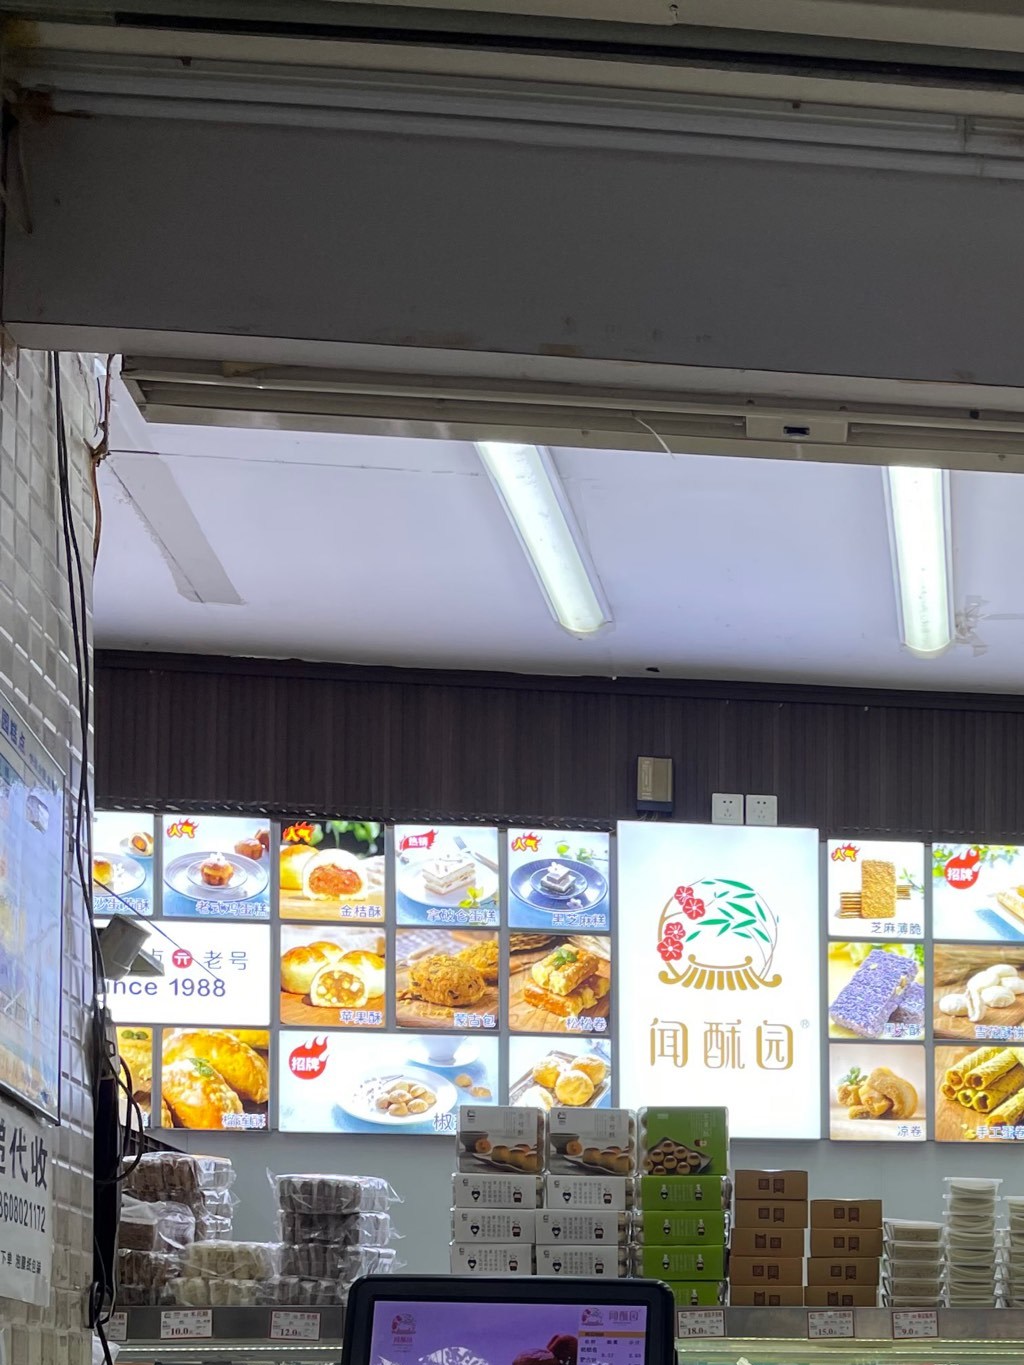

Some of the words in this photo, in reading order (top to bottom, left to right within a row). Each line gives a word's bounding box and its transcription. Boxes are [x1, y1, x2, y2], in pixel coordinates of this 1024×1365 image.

[946, 867, 973, 882] 招牌
[195, 900, 268, 916] 老式鸡蛋糕
[341, 905, 382, 918] 金桔酥
[426, 908, 496, 923] 拿破仑蛋糕
[553, 914, 606, 927] 黑芝麻糕
[870, 922, 922, 936] 芝麻薄脆
[203, 949, 249, 970] 老号
[104, 979, 158, 997] ince
[169, 978, 227, 997] 1988
[340, 1010, 382, 1025] 苹果酥
[454, 1013, 496, 1028] 蒙古包
[565, 1016, 607, 1032] 松松卷
[649, 1017, 795, 1071] 闻酥园
[291, 1056, 320, 1071] 招牌
[433, 1112, 457, 1131] 椒
[896, 1124, 922, 1138] 凉卷
[0, 1118, 48, 1191] 代收
